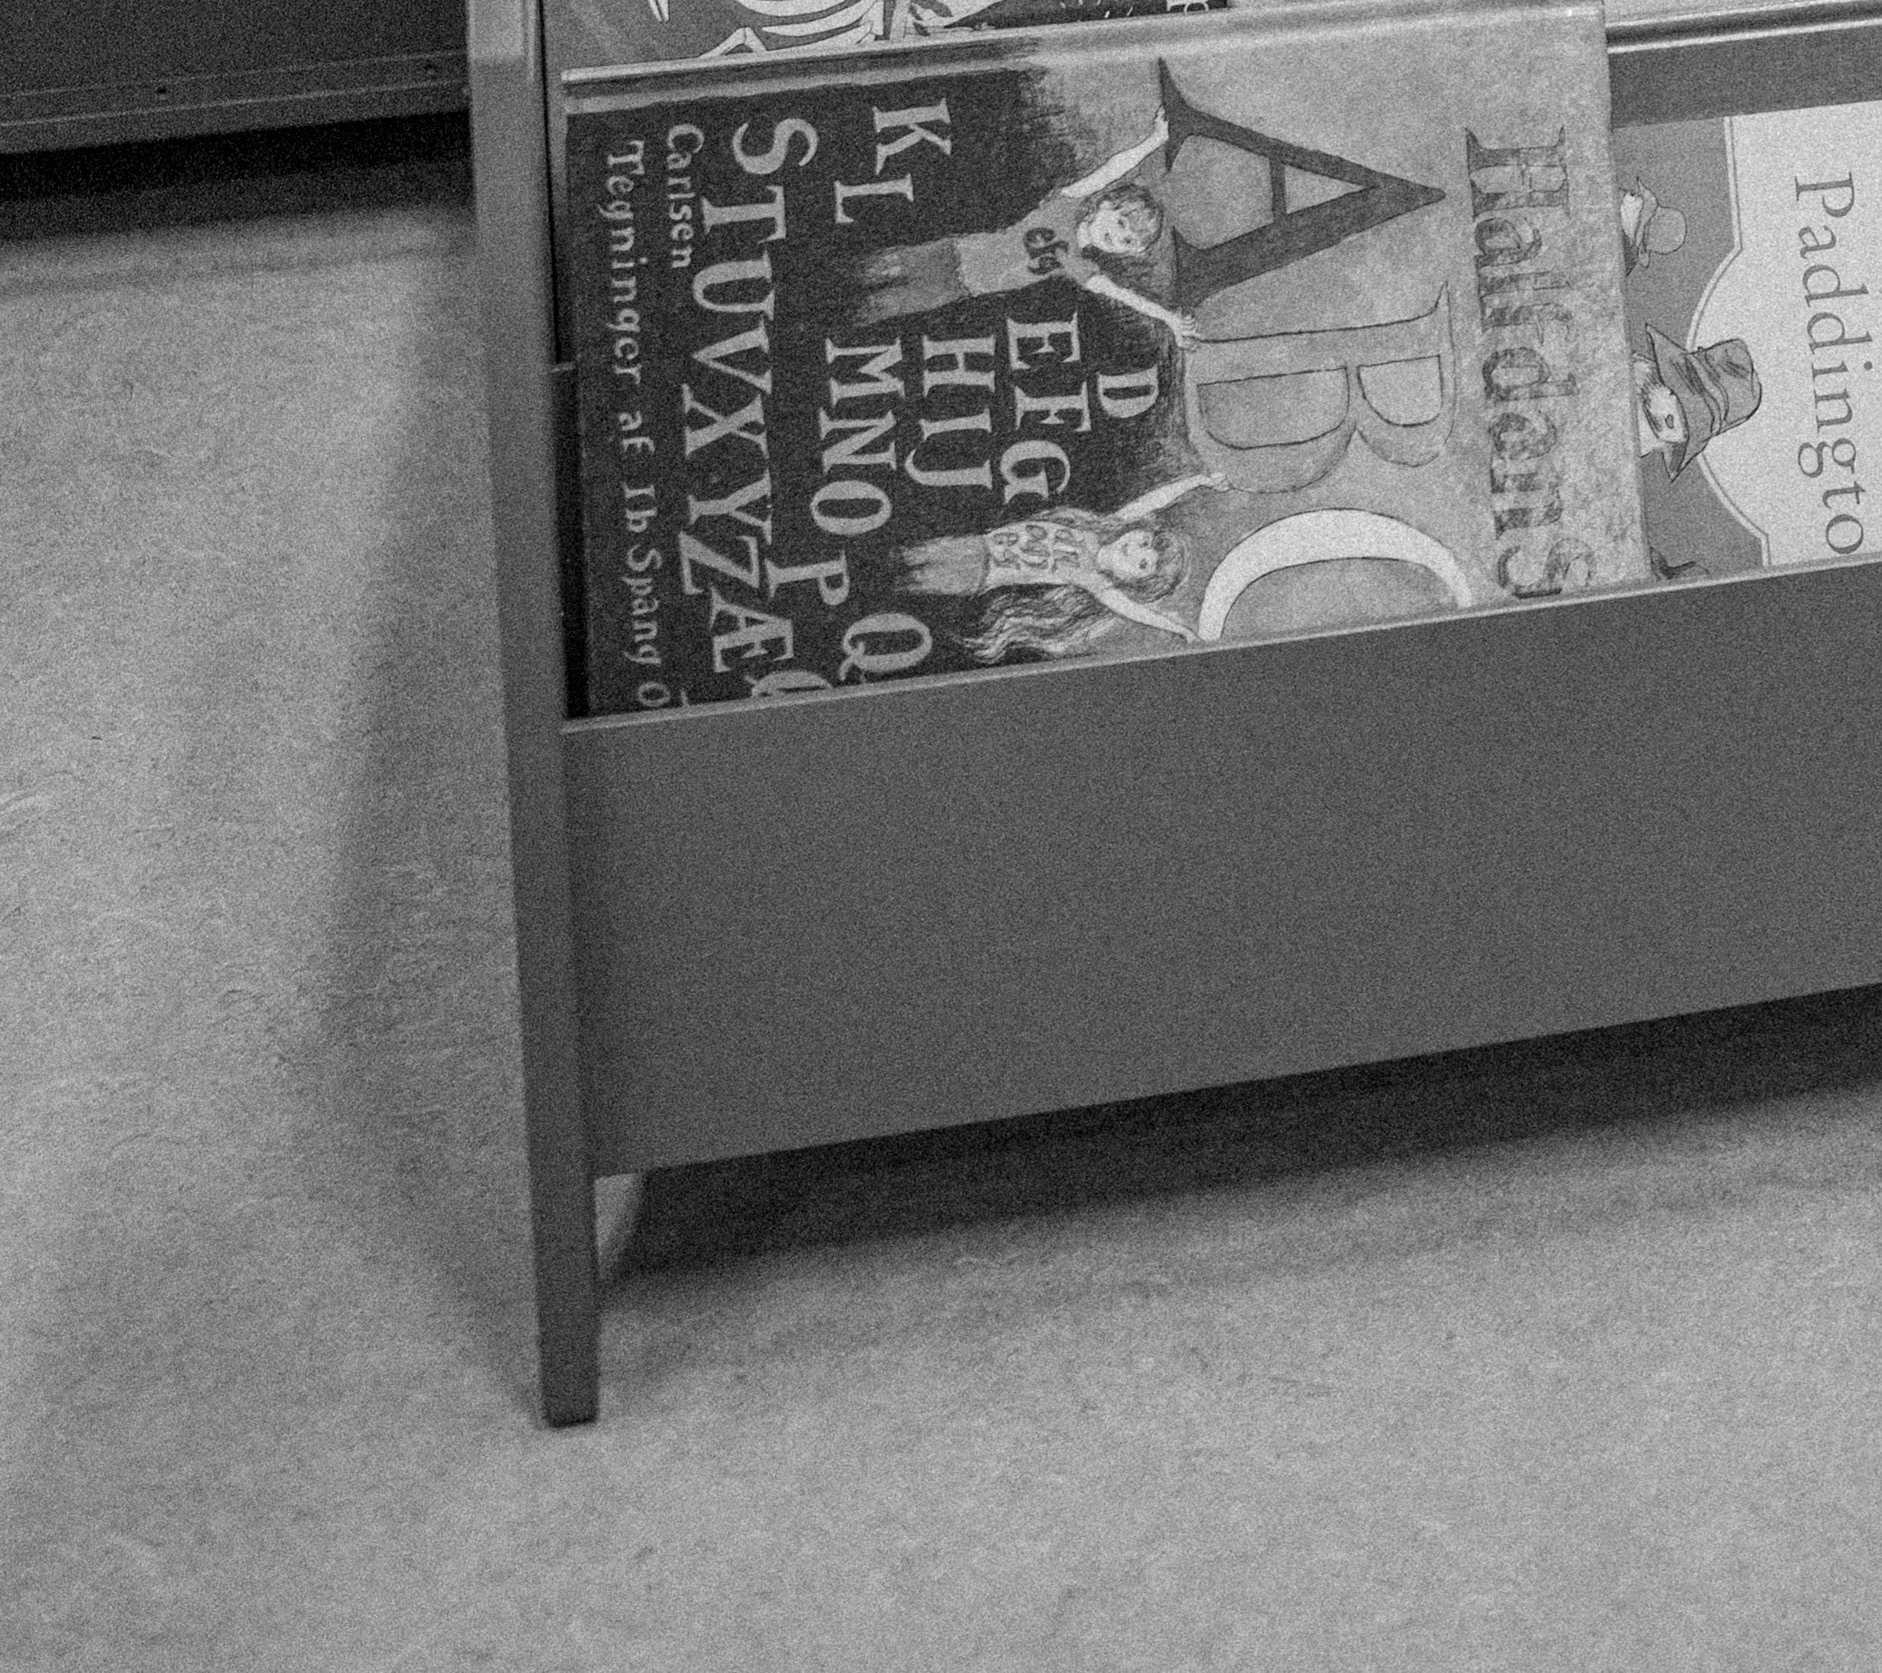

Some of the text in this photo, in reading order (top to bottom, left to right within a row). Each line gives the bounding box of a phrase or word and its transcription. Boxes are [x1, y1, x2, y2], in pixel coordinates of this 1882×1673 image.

[598, 138, 646, 386] Tegninger
[665, 123, 705, 270] Carlsen
[616, 409, 656, 455] af
[904, 334, 998, 491] HIJ
[1001, 312, 1093, 504] EFG
[1096, 364, 1160, 419] D
[1462, 124, 1602, 601] Halfdans
[1793, 171, 1874, 556] Paddingto
[621, 483, 657, 534] Ib
